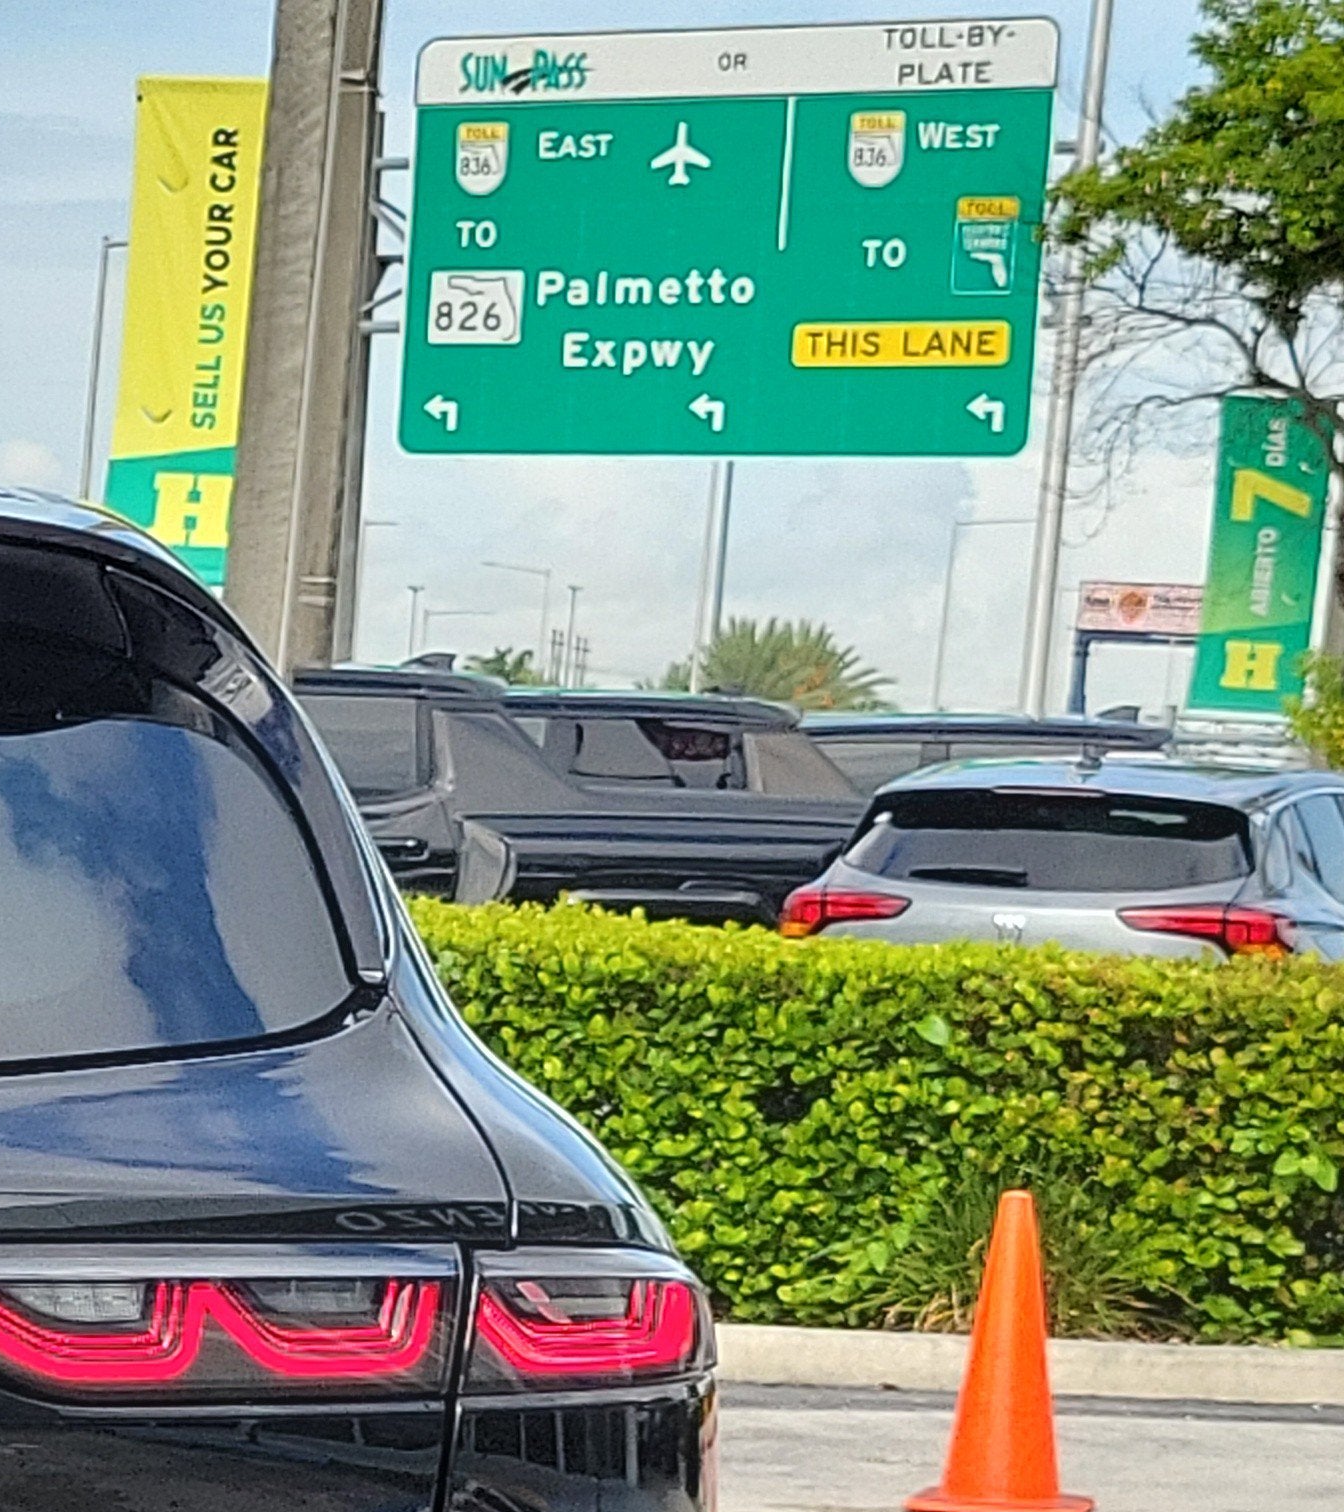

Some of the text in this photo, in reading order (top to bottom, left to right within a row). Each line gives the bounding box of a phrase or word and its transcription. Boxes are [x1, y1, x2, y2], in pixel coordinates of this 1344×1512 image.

[459, 48, 588, 93] SUN PASS
[718, 52, 748, 73] OR
[897, 61, 993, 86] PLATE
[538, 131, 613, 160] EAST
[917, 121, 1001, 150] WEST
[460, 156, 492, 176] 836
[456, 220, 498, 248] TO
[862, 237, 907, 268] TO
[191, 127, 239, 430] SELL US YOUR CAR
[536, 268, 755, 306] Palmetto
[434, 301, 503, 332] 826
[562, 332, 715, 375] Expwy
[806, 330, 998, 358] THIS LANE
[1230, 468, 1312, 521] 7
